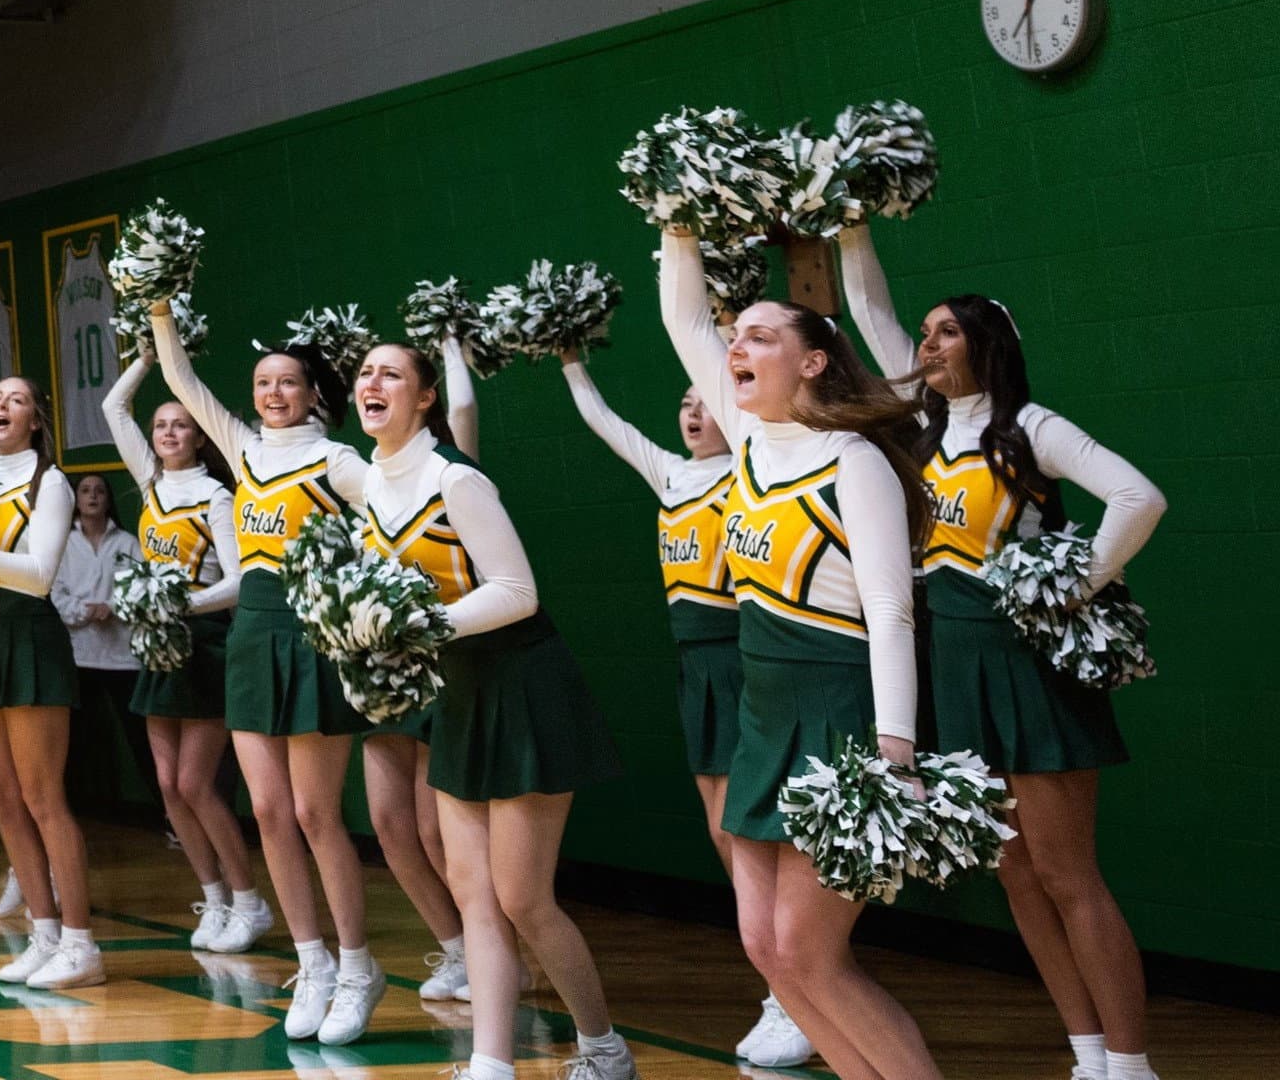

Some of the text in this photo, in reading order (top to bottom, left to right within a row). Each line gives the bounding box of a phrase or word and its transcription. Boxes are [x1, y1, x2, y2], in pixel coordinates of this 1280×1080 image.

[74, 324, 104, 389] 10
[241, 503, 286, 536] Irish
[145, 527, 179, 558] Irish
[660, 528, 699, 564] Irish
[724, 514, 775, 562] Irish
